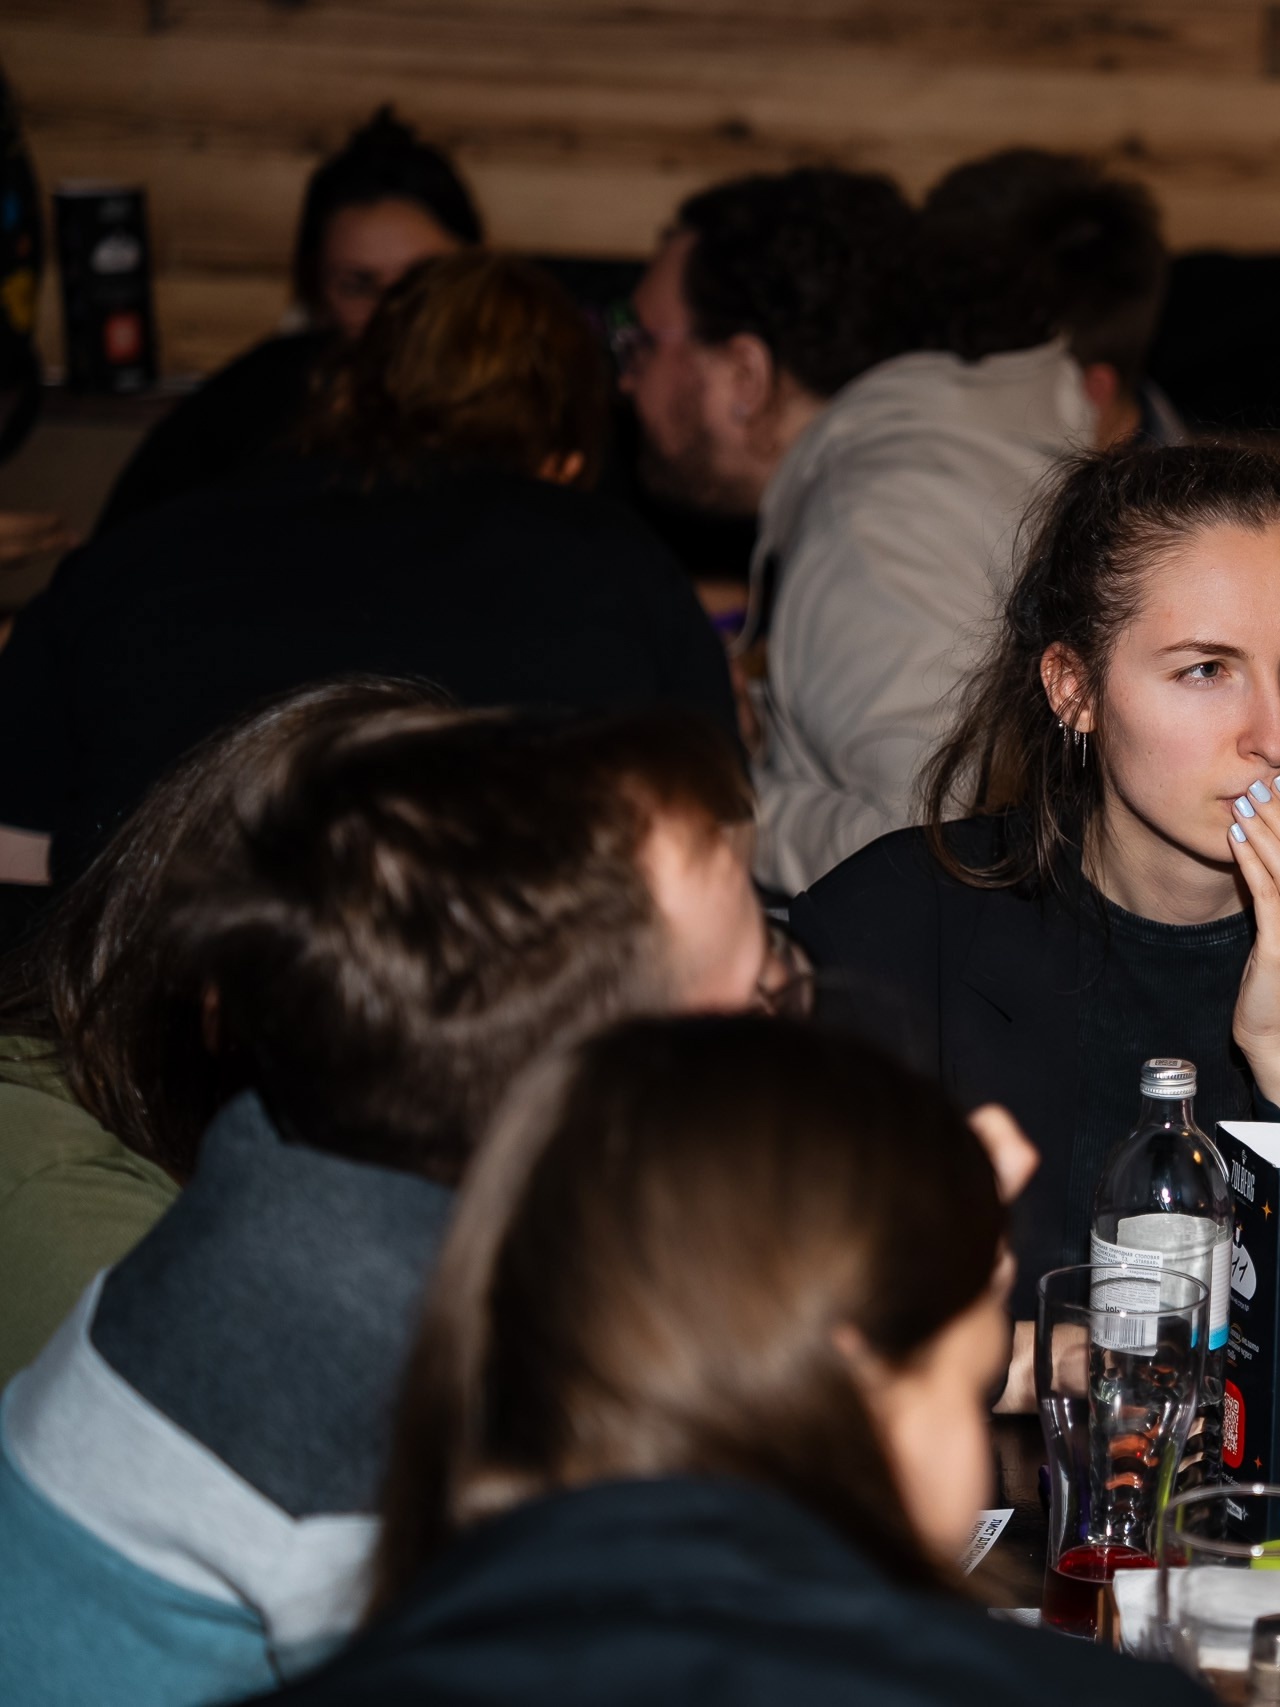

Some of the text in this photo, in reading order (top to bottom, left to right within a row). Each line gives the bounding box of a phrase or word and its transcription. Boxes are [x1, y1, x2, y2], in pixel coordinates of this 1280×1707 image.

[1231, 1159, 1255, 1203] ZOLBERG
[983, 1519, 1003, 1537] ЛИСТ
[973, 1536, 991, 1550] ДЛЯ
